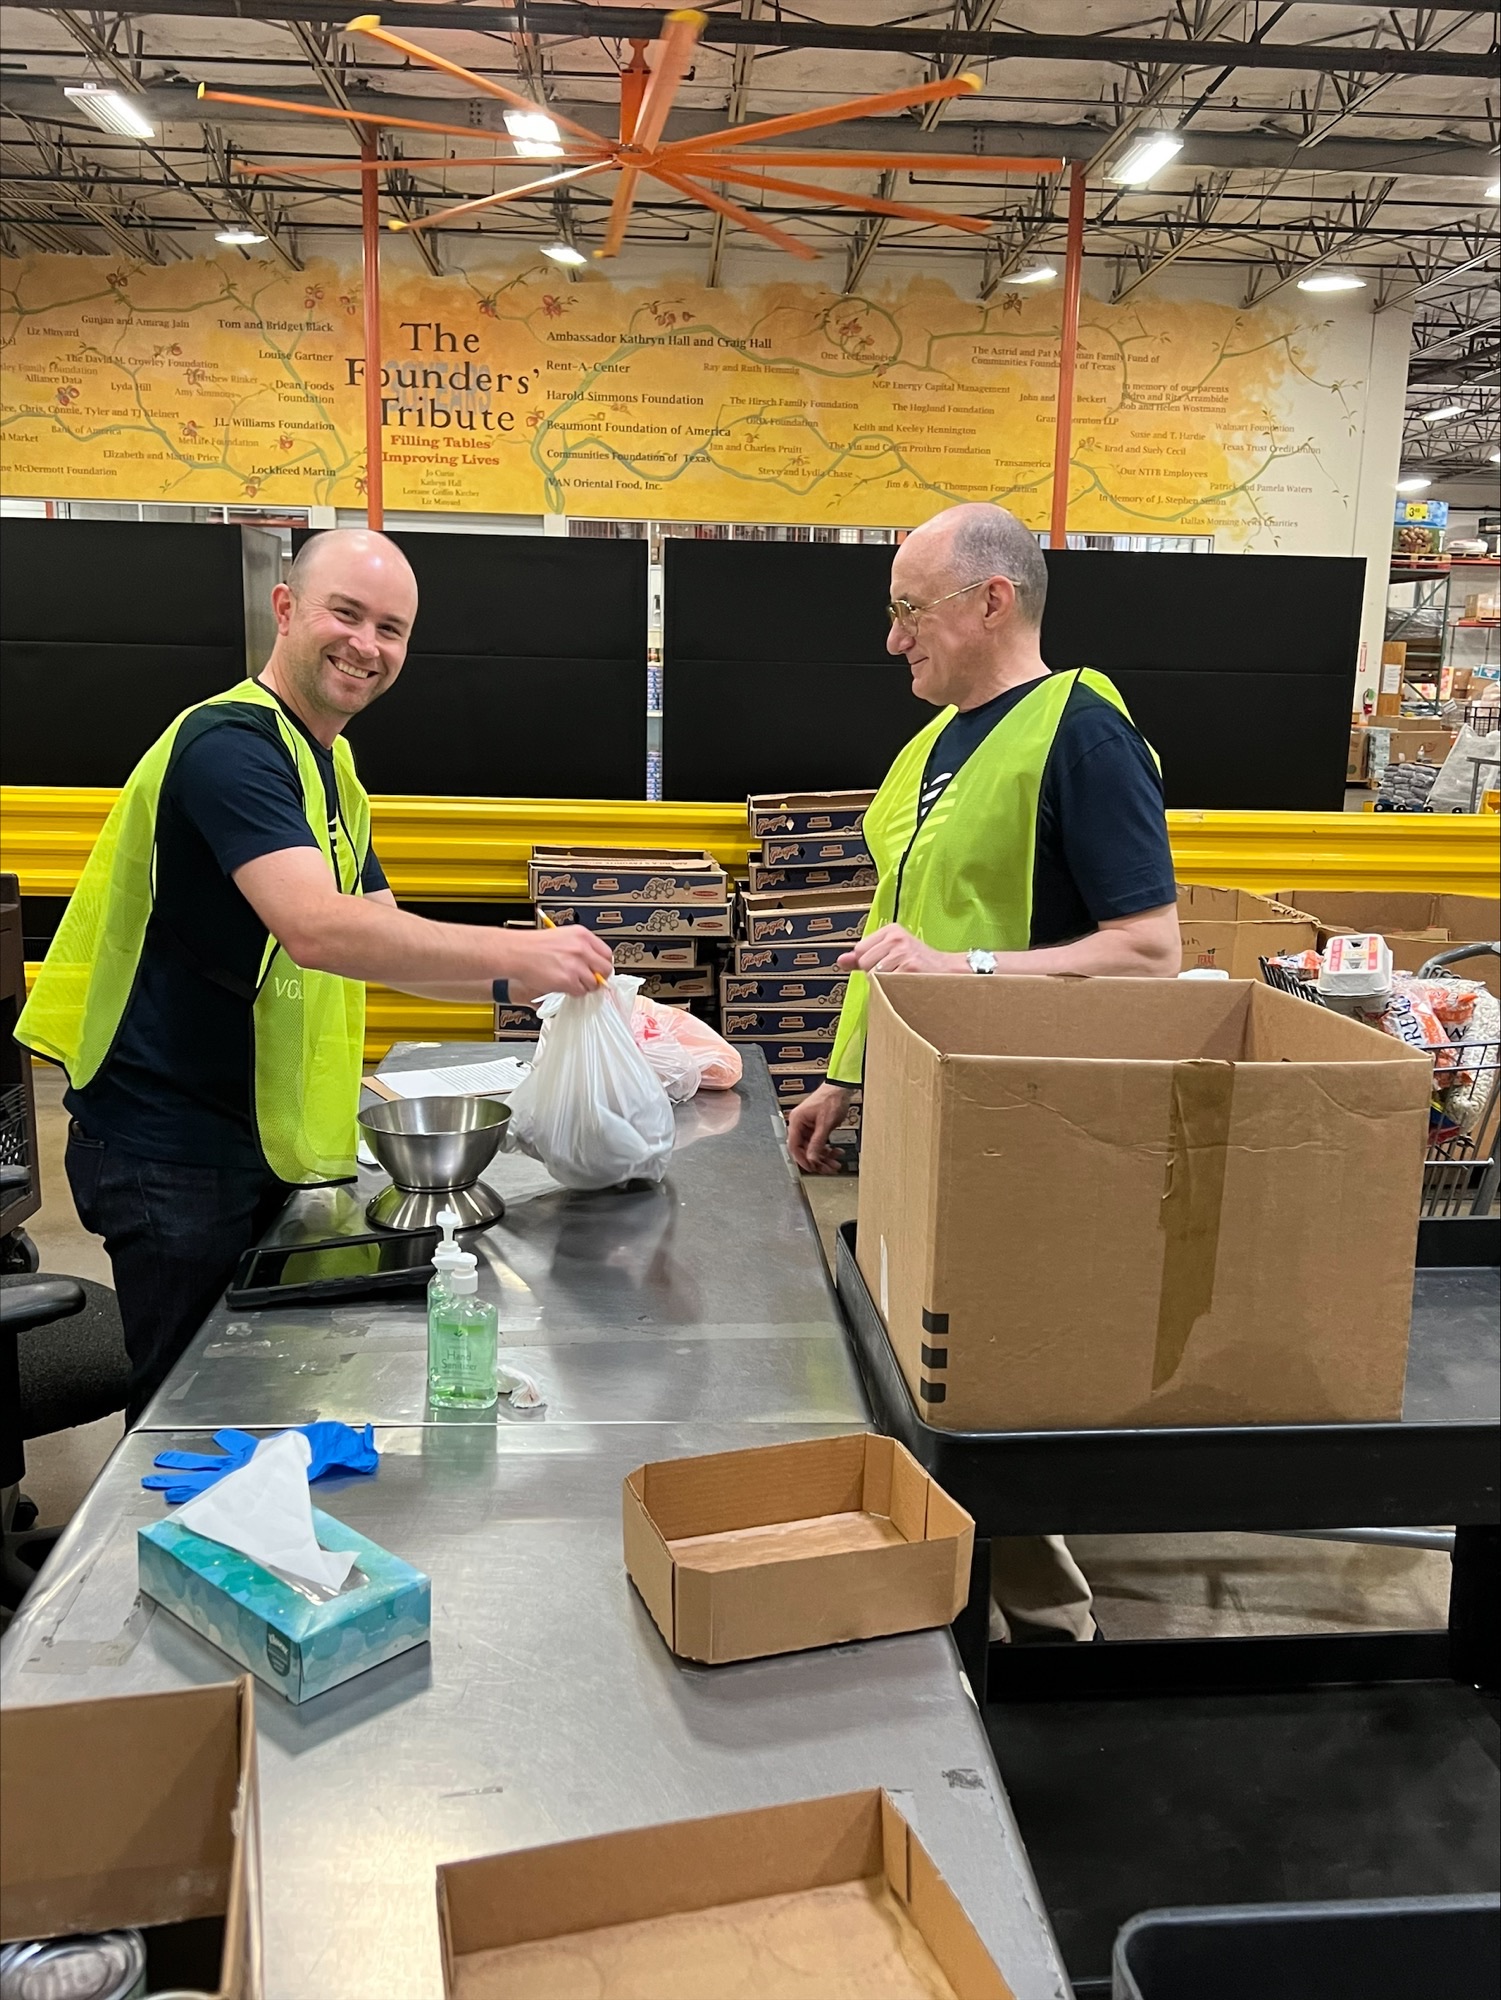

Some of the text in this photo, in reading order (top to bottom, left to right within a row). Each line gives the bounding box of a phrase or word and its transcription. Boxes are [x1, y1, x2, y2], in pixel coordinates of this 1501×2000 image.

[117, 317, 133, 325] and
[172, 319, 190, 328] Jain
[217, 319, 334, 332] Tom and Bridget Black
[399, 322, 480, 353] The
[546, 331, 772, 350] Ambassador Kathryn Hall and Craig Hall
[259, 349, 334, 361] Louise Gartner
[821, 352, 838, 360] One
[972, 346, 1160, 363] The Astrid and Pat Family Fund of
[65, 354, 219, 369] The David Crowley Foundation
[546, 360, 631, 373] Rent-A-Center
[971, 356, 1116, 371] Communities of Texas
[721, 364, 739, 372] and
[25, 374, 82, 384] Alliance Data
[345, 358, 540, 394] Founders'
[275, 380, 335, 391] Dean Foods
[892, 381, 923, 391] Energy
[925, 382, 955, 392] Capital
[1132, 384, 1168, 393] memory
[1197, 385, 1230, 394] parents
[278, 393, 335, 404] Foundation
[546, 390, 704, 405] Harold Simmons Foundation
[1040, 394, 1056, 402] and
[1147, 393, 1163, 401] and
[730, 396, 859, 410] The Hirsch Family Foundation
[1138, 402, 1154, 410] and
[84, 407, 128, 416] Tyler and
[380, 397, 515, 431] Tribute
[892, 403, 908, 411] The
[948, 405, 995, 415] Foundation
[213, 417, 335, 430] J.L. Williams Foundation
[546, 420, 731, 437] Beaumont Foundation of America
[853, 423, 876, 432] Keith
[878, 424, 894, 432] and
[8, 433, 38, 442] Market
[1152, 431, 1168, 439] and
[391, 435, 491, 449] Filling Tables
[725, 443, 742, 451] and
[744, 443, 776, 452] Charles
[864, 443, 880, 451] and
[944, 445, 991, 455] Foundation
[1125, 445, 1141, 453] and
[103, 450, 220, 461] Elizabeth and Price
[382, 452, 500, 467] Improving Lives
[546, 449, 711, 463] Communities Foundation of Texas
[994, 459, 1051, 468] Transamerica
[14, 464, 117, 476] McDermott Foundation
[251, 465, 336, 476] Lockheed Martin
[784, 468, 799, 476] and
[573, 478, 613, 488] Oriental
[616, 480, 642, 490] Food,
[645, 481, 662, 490] Inc.
[1145, 495, 1156, 503] of
[446, 1349, 472, 1361] Hand
